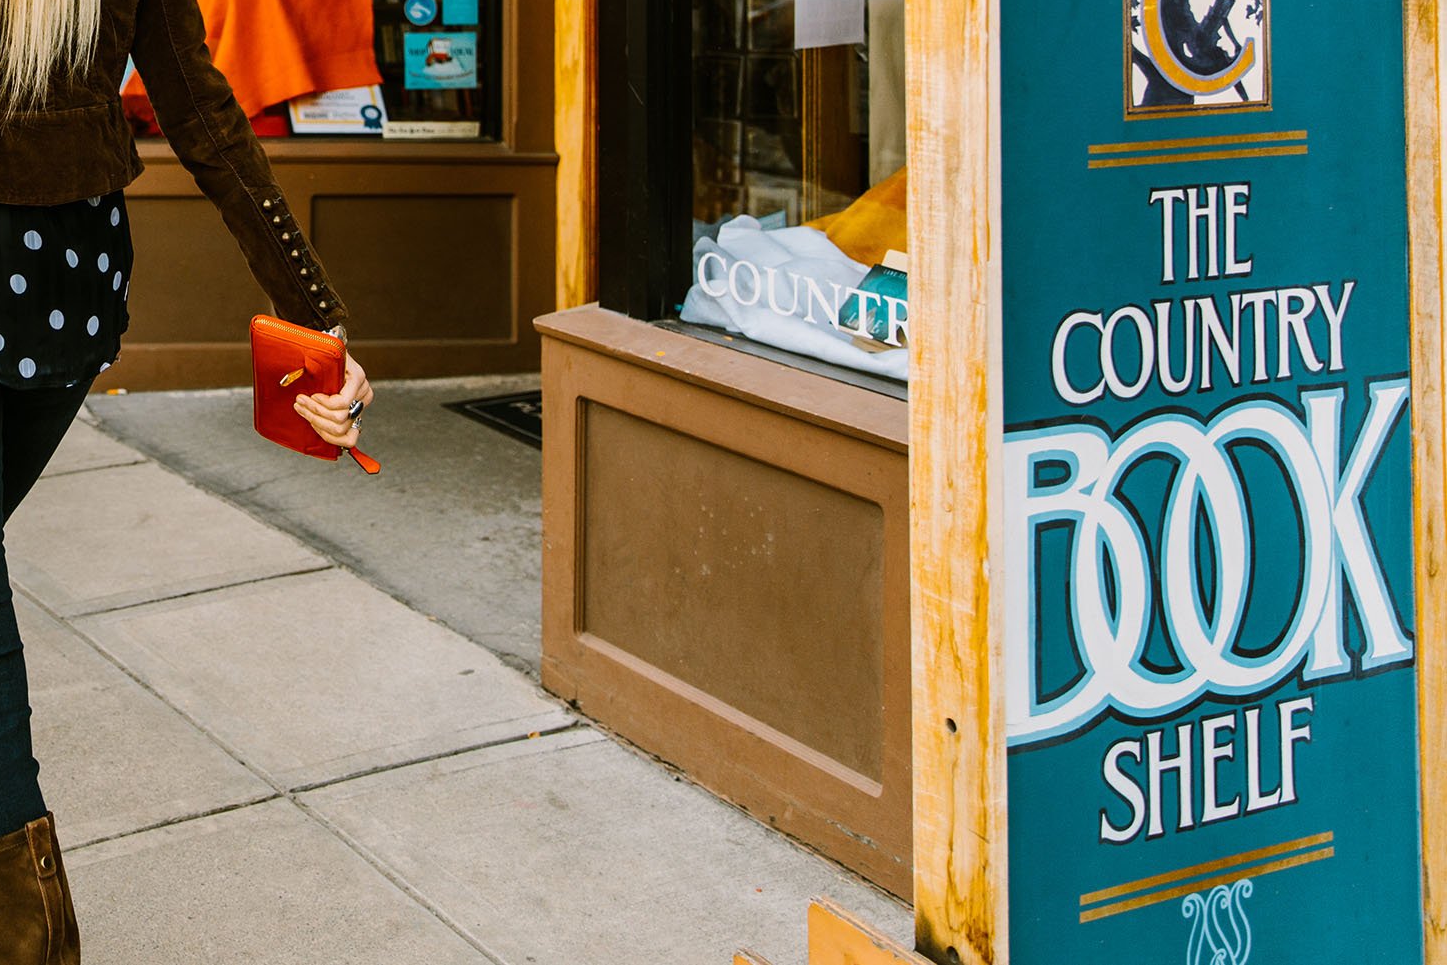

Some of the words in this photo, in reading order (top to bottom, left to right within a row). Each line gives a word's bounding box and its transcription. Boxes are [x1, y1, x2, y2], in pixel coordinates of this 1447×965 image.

[1149, 182, 1254, 284] THE
[1051, 280, 1356, 406] COUNTRY
[1002, 376, 1413, 744] BOOK
[1097, 696, 1318, 846] SHELF
